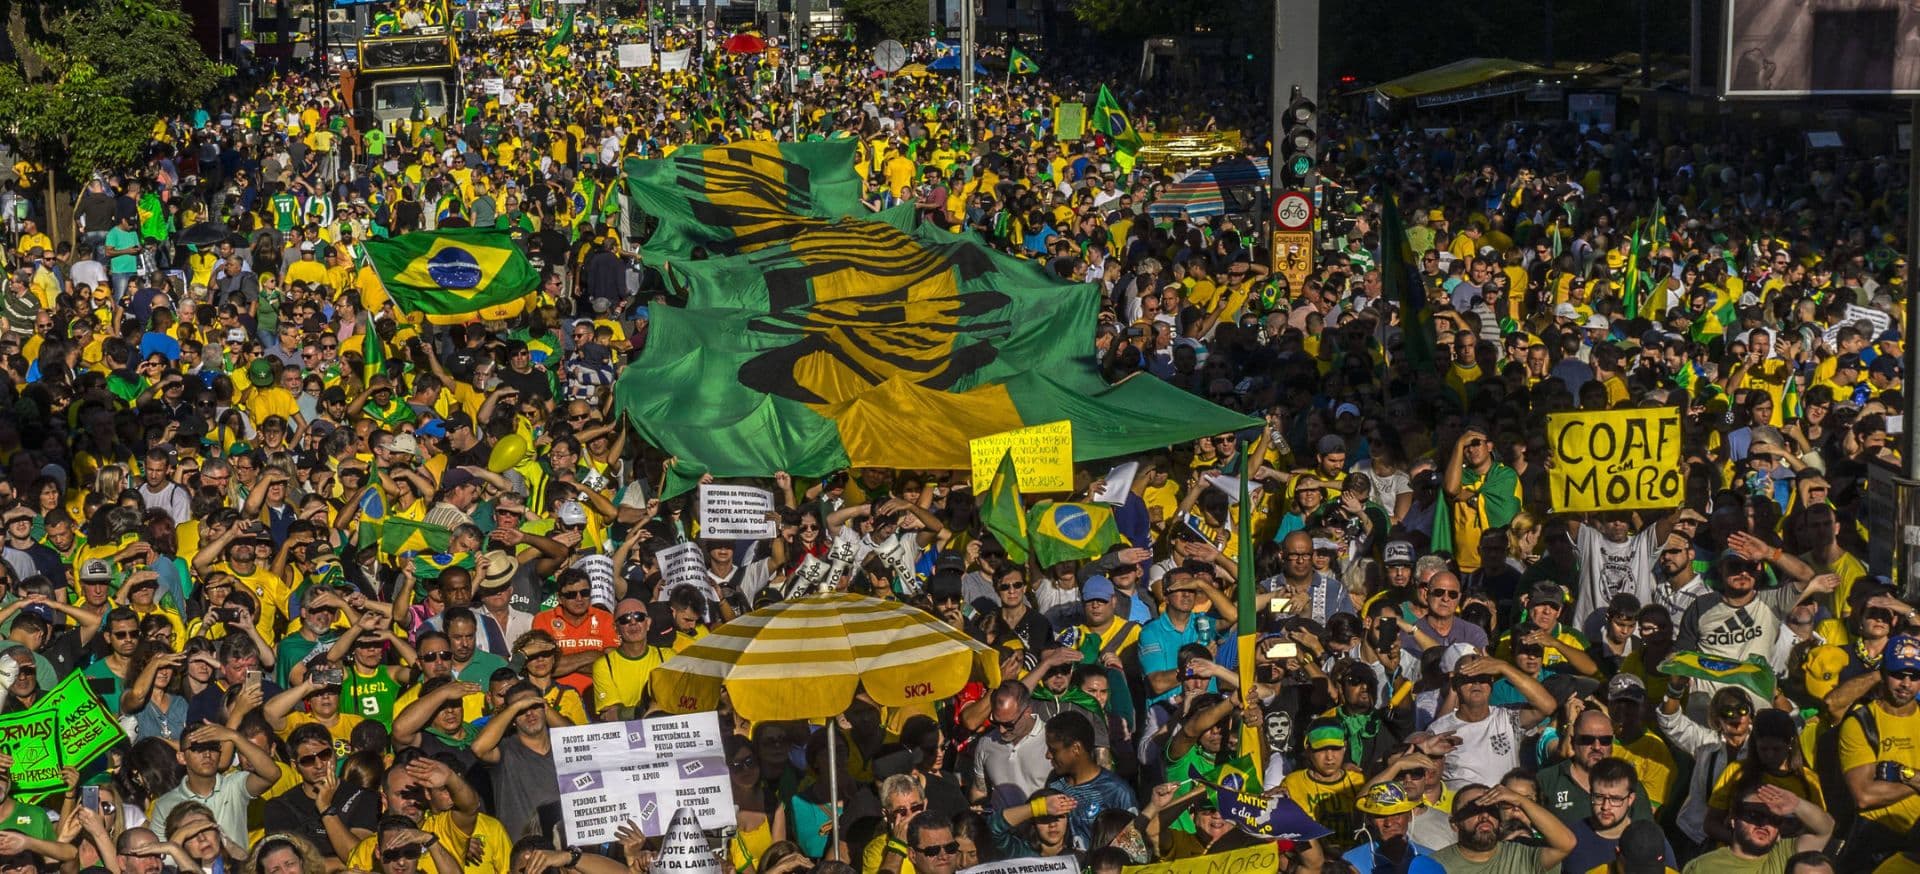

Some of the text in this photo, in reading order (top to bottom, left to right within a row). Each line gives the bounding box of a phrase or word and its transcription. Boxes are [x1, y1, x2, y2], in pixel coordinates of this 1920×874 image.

[279, 202, 290, 213] 11
[1557, 418, 1678, 464] COAF
[1564, 465, 1680, 508] MORO
[1707, 626, 1763, 646] adidas
[558, 639, 577, 648] ITED
[904, 682, 935, 699] SKOL
[361, 696, 380, 716] 9
[651, 722, 679, 732] REFORMA
[561, 731, 621, 745] PACOTE ANTI-CRIME
[654, 742, 674, 751] PAULO
[675, 740, 697, 749] GUEDES
[684, 761, 701, 773] TOGA
[575, 775, 593, 788] LAVA
[642, 771, 660, 780] APOIO
[675, 785, 722, 797] BRASIL CONTRA
[1557, 790, 1569, 803] 87
[572, 794, 607, 807] PEDIDOS DE
[683, 796, 710, 807] CENTRÃO
[1236, 793, 1268, 809] ANTIC
[574, 802, 627, 818] IMPEACHMENT DE
[698, 807, 716, 817] APOIO
[575, 815, 608, 829] MINISTROS
[609, 814, 618, 823] DO
[682, 816, 692, 826] DA
[577, 828, 606, 840] EU APOIO
[683, 830, 699, 841] Voto
[662, 845, 686, 855] COTE
[669, 859, 682, 869] DA
[684, 858, 706, 869] LAVA
[1007, 866, 1018, 874] DA
[1018, 861, 1069, 874] PREVIDÊNCIA
[1206, 852, 1276, 874] MORO
